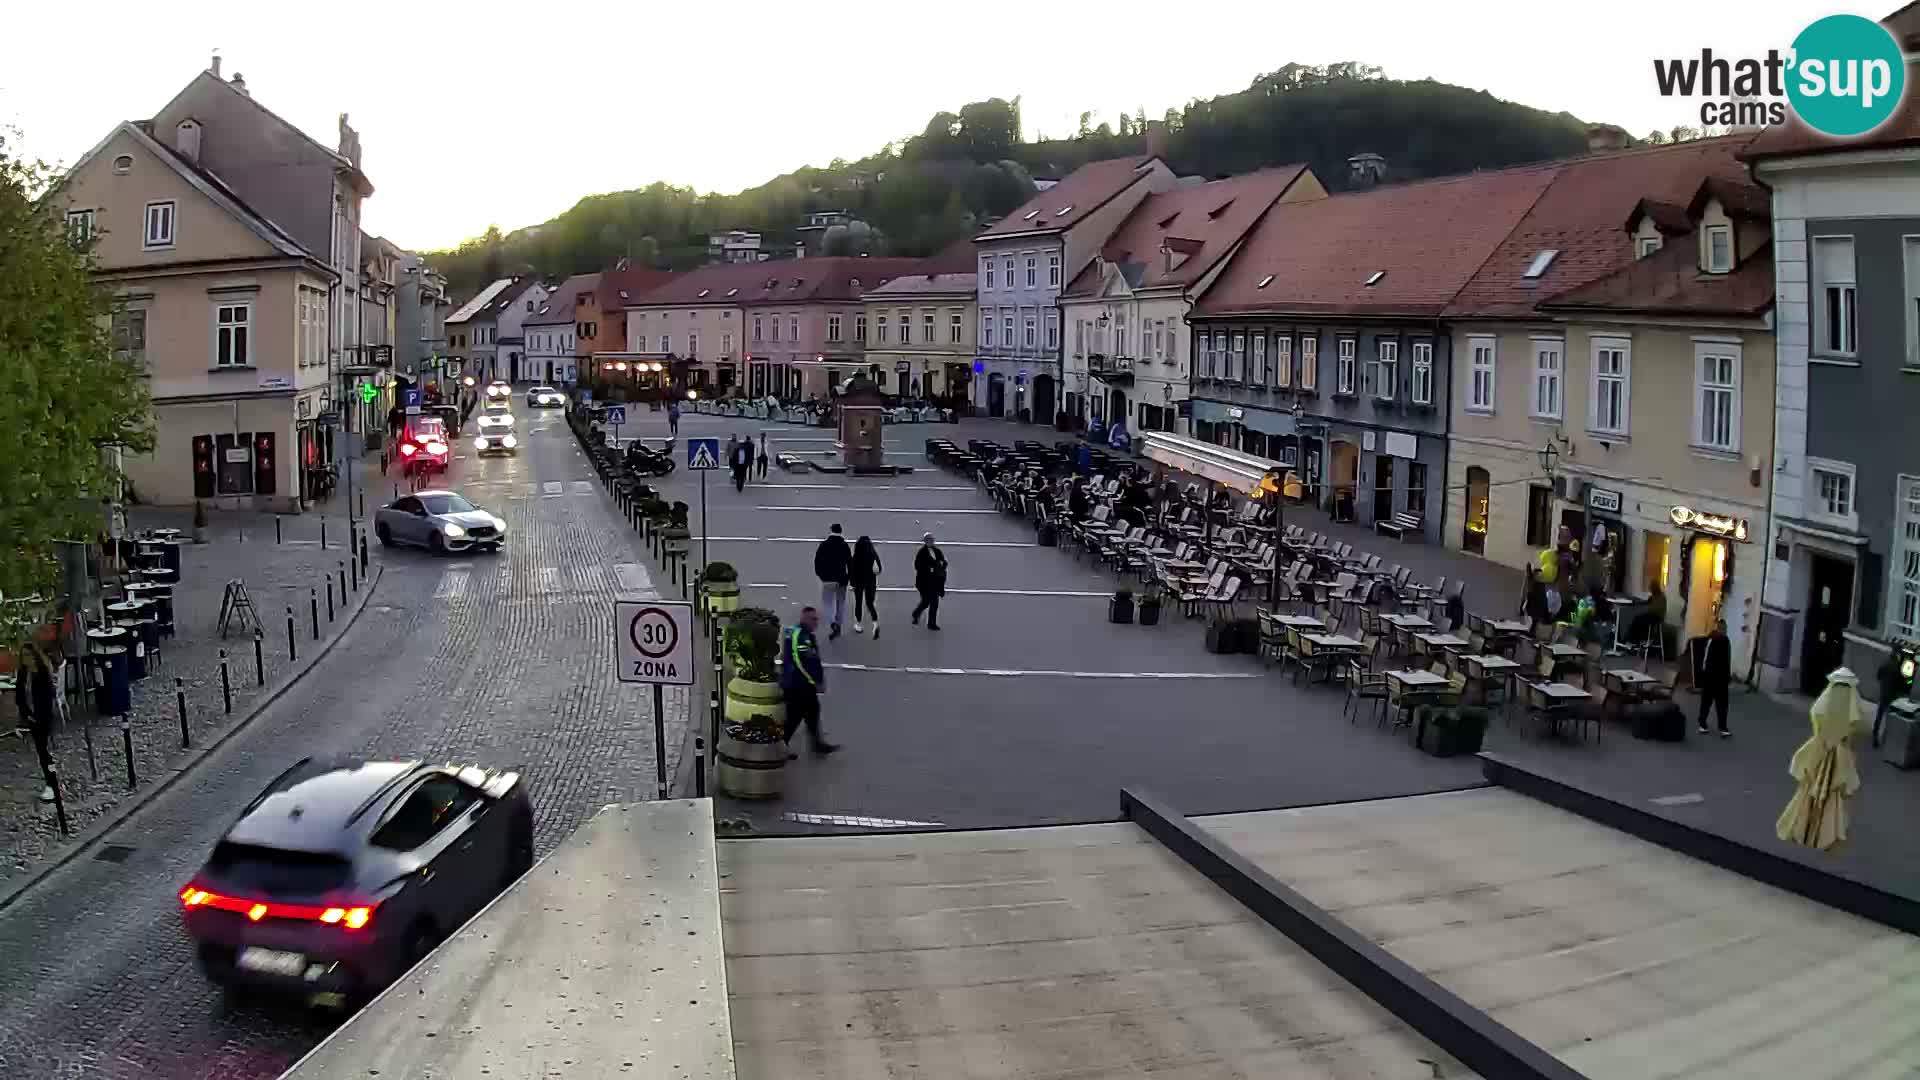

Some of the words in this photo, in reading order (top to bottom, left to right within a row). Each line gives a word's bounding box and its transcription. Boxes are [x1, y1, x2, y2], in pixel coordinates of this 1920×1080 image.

[409, 392, 417, 405] P
[643, 623, 667, 645] 30
[633, 661, 677, 677] ZONA
